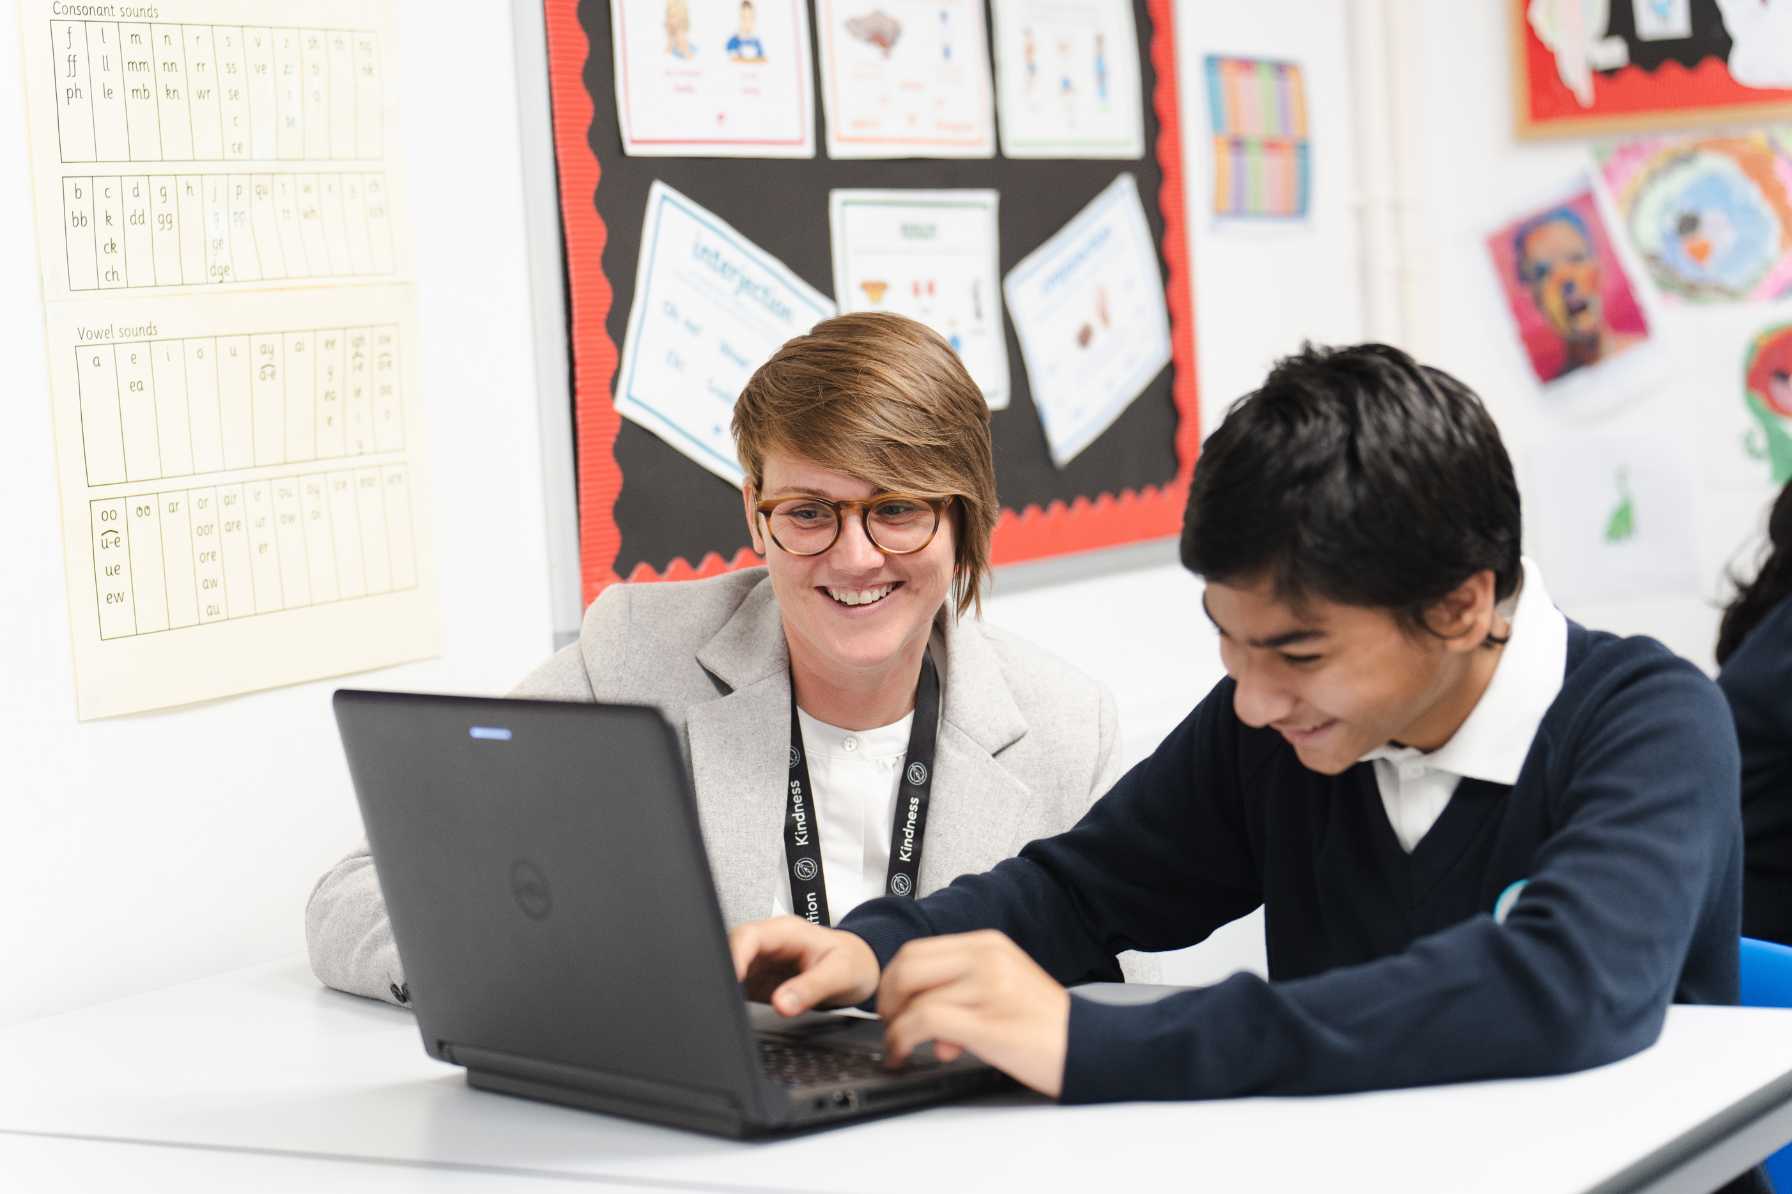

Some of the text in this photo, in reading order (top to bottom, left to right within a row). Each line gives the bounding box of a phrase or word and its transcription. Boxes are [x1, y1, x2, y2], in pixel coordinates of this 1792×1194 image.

[52, 1, 160, 19] Consonant sounds
[130, 32, 143, 45] m
[163, 31, 172, 46] n
[223, 35, 232, 48] s
[66, 53, 78, 79] ff
[102, 54, 111, 72] ll
[127, 60, 150, 73] mm
[162, 61, 179, 73] nn
[196, 61, 207, 73] rr
[225, 61, 238, 75] ss
[66, 82, 83, 106] ph
[102, 82, 114, 100] le
[131, 82, 152, 101] mb
[164, 82, 180, 100] kn
[196, 88, 211, 101] wr
[74, 182, 83, 200] b
[131, 180, 141, 199] d
[159, 183, 168, 204] g
[185, 181, 195, 197] h
[71, 210, 88, 229] bb
[129, 208, 146, 226] dd
[157, 212, 174, 232] gg
[103, 236, 118, 255] ck
[104, 264, 121, 283] ch
[77, 321, 159, 341] Vowel sounds
[92, 355, 102, 368] a
[195, 347, 205, 361] o
[129, 379, 145, 393] ea
[168, 501, 180, 514] ar
[196, 497, 209, 511] or
[100, 508, 118, 522] oo
[195, 523, 215, 537] oor
[198, 550, 217, 565] ore
[104, 563, 121, 577] ue
[201, 577, 219, 591] aw
[105, 591, 125, 605] ew
[205, 604, 221, 617] au
[790, 780, 809, 846] Kindness
[899, 796, 920, 862] Kindness
[805, 892, 820, 925] tion
